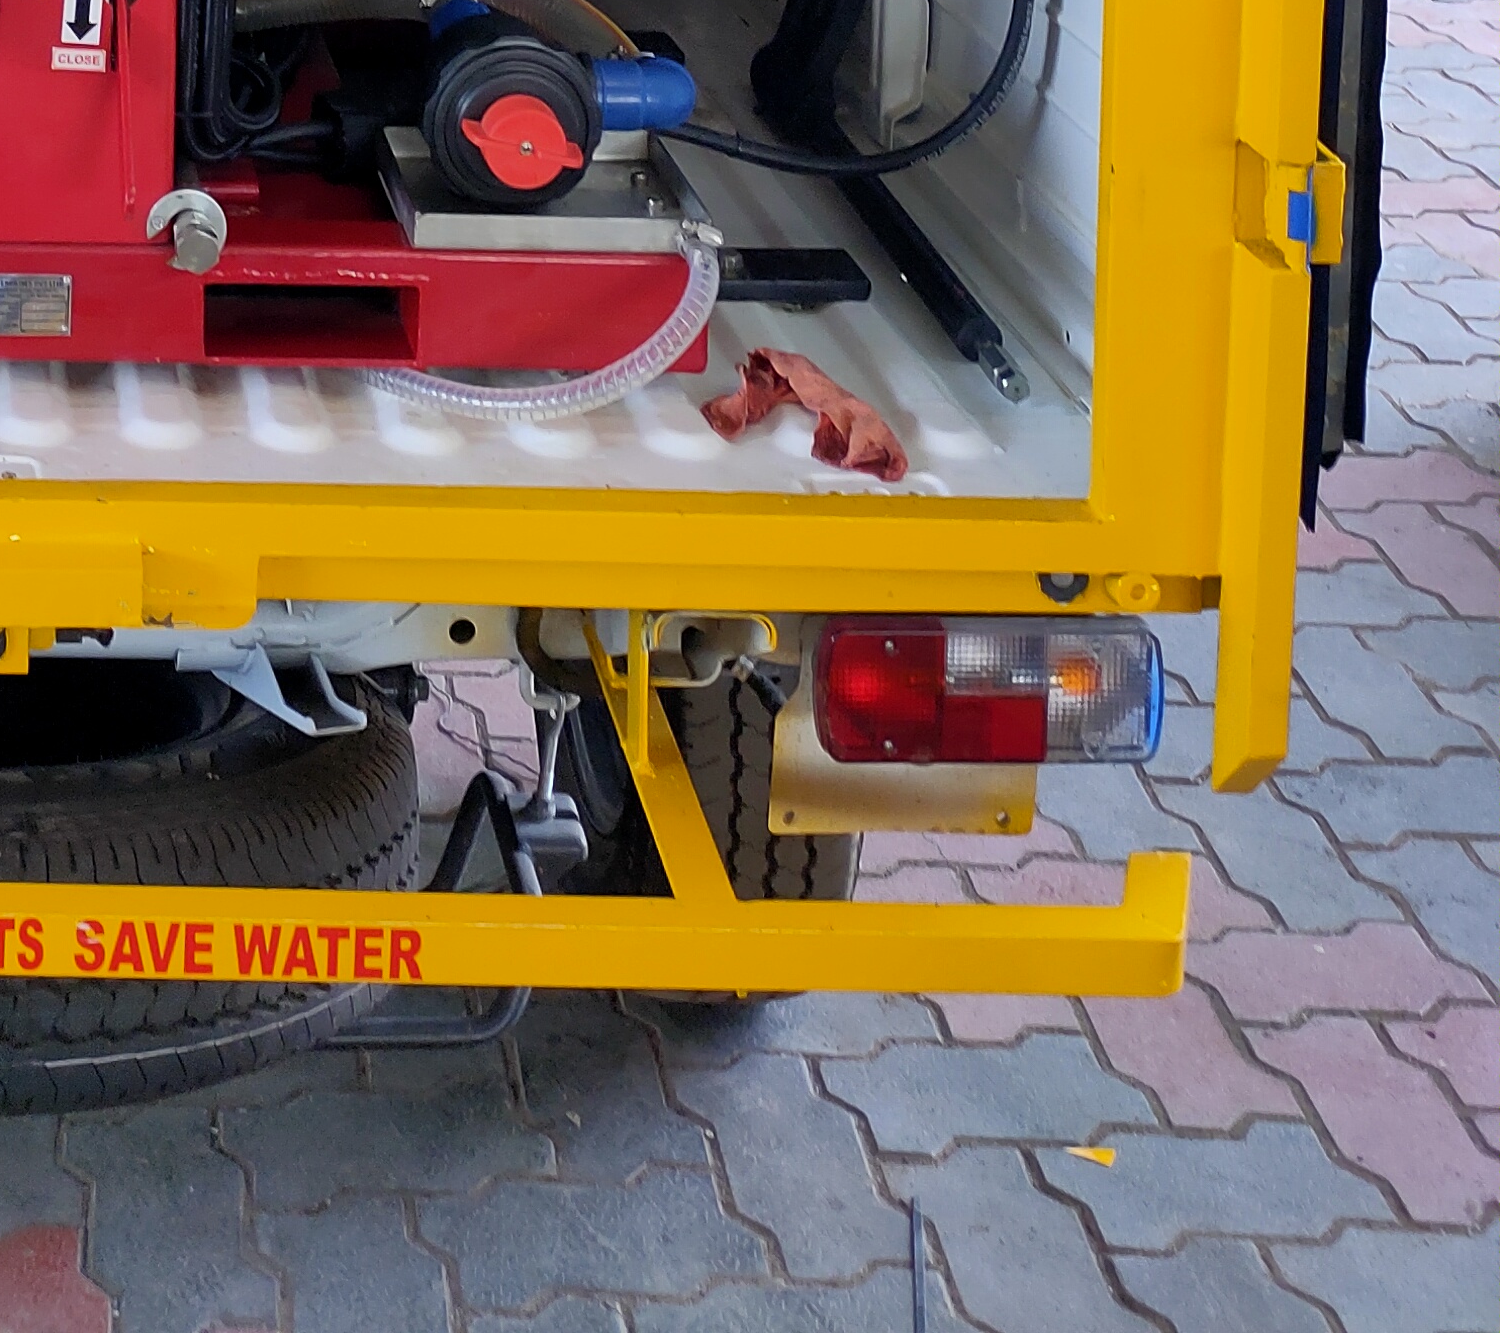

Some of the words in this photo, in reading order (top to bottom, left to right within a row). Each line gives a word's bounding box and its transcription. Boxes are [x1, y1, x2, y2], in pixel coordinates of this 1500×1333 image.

[58, 53, 101, 66] CLOSE
[74, 919, 214, 974] SAVE
[233, 923, 423, 980] WATER
